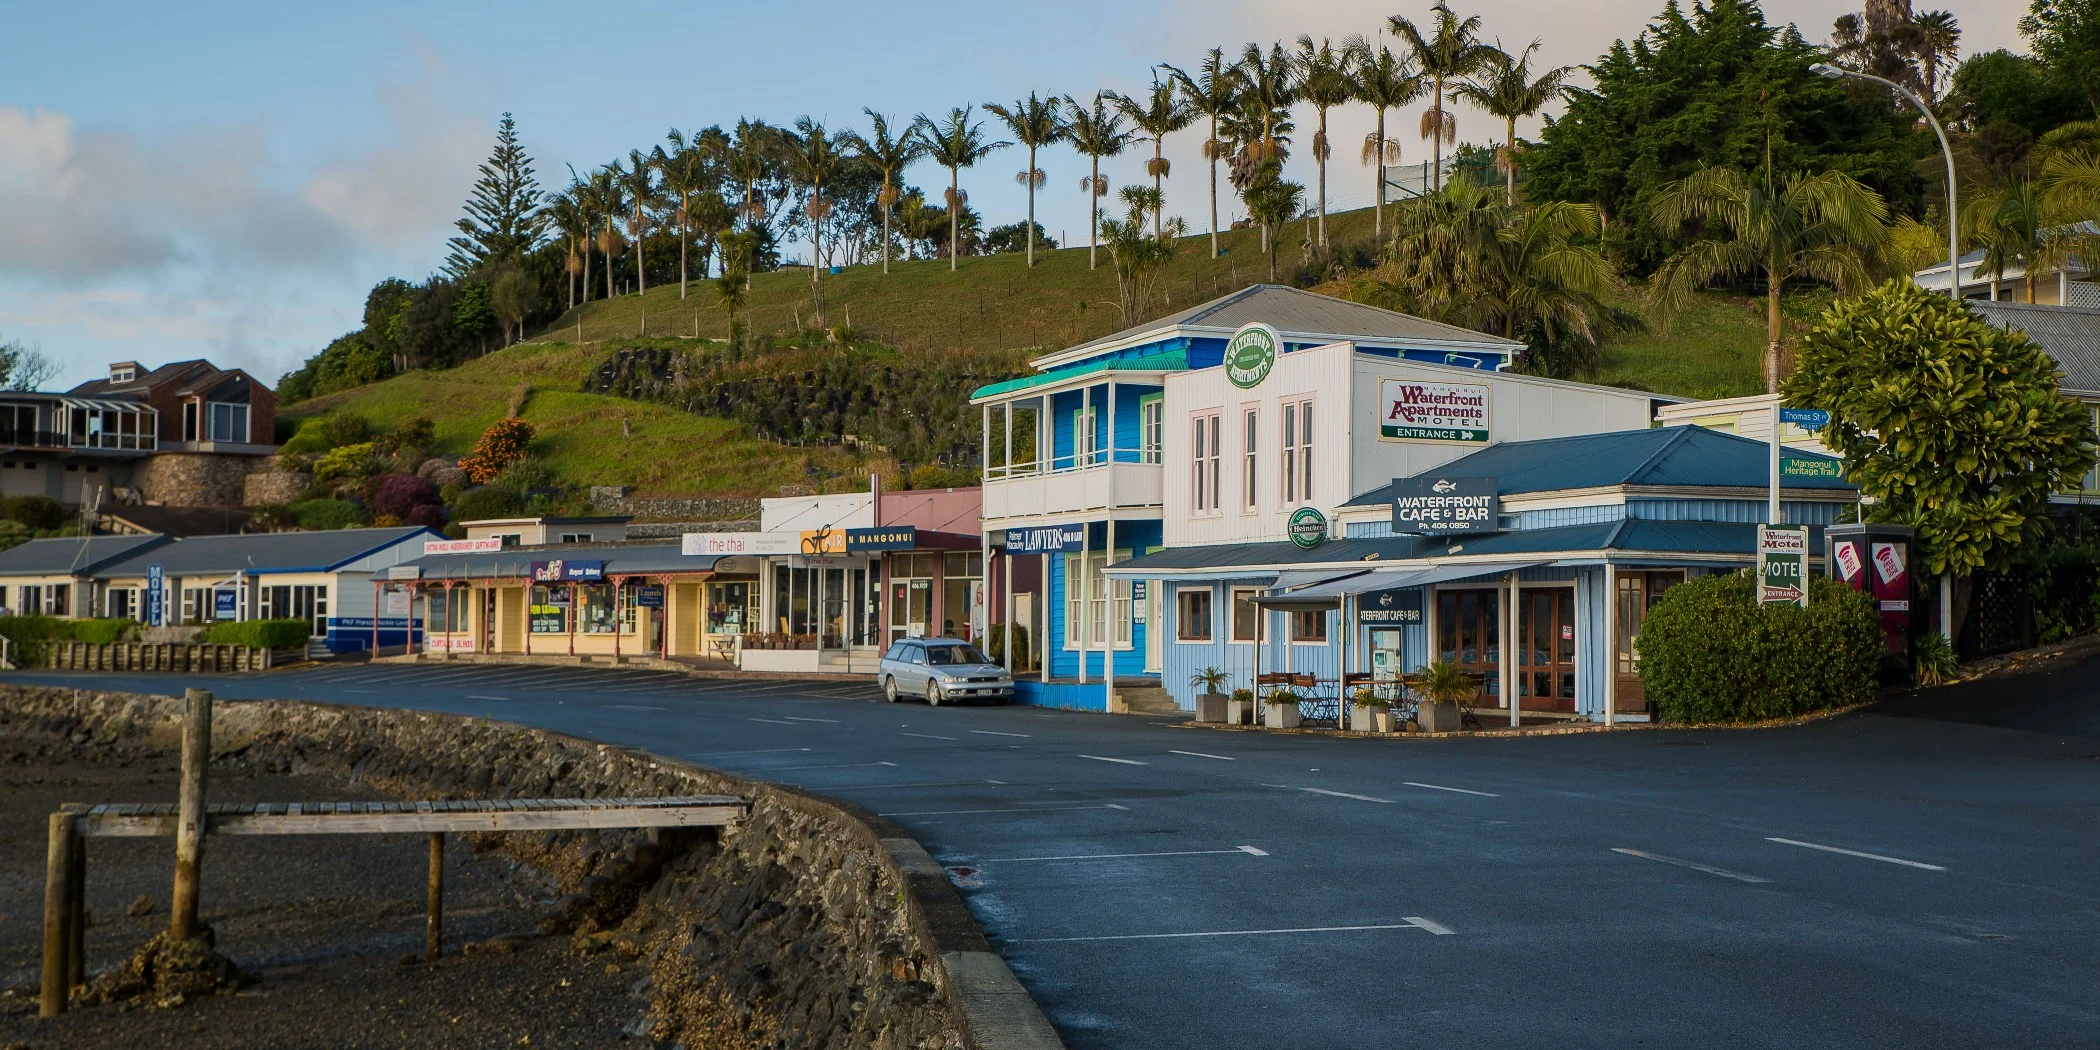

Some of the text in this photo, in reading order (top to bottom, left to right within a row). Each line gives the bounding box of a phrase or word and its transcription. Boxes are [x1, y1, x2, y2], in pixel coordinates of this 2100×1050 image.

[1229, 332, 1270, 360] WATERFRONT
[1399, 384, 1483, 406] Waterfront
[1424, 386, 1481, 394] MANGONUI
[1388, 400, 1482, 422] Apartments
[1785, 411, 1810, 421] Thomas
[1813, 412, 1820, 421] St
[1418, 417, 1483, 427] MOTEL
[1398, 428, 1456, 439] ENTRANCE
[1791, 459, 1831, 469] Mangonui
[1785, 466, 1835, 476] Heritage Trail
[1398, 496, 1491, 508] WATERFRONT
[1400, 507, 1489, 521] CAFE & BAR
[1293, 524, 1324, 533] Heineken
[860, 533, 912, 544] MANGONUI
[1025, 528, 1063, 551] LAWYERS
[1765, 531, 1802, 540] Waterfront
[709, 537, 745, 552] the thai
[1762, 540, 1804, 549] Motel
[1761, 561, 1806, 577] MOTEL
[150, 566, 160, 626] MOTEL
[217, 594, 234, 603] PKF
[1767, 590, 1799, 598] ENTRANCE
[1390, 610, 1404, 621] CAFE
[1408, 610, 1420, 621] BAR
